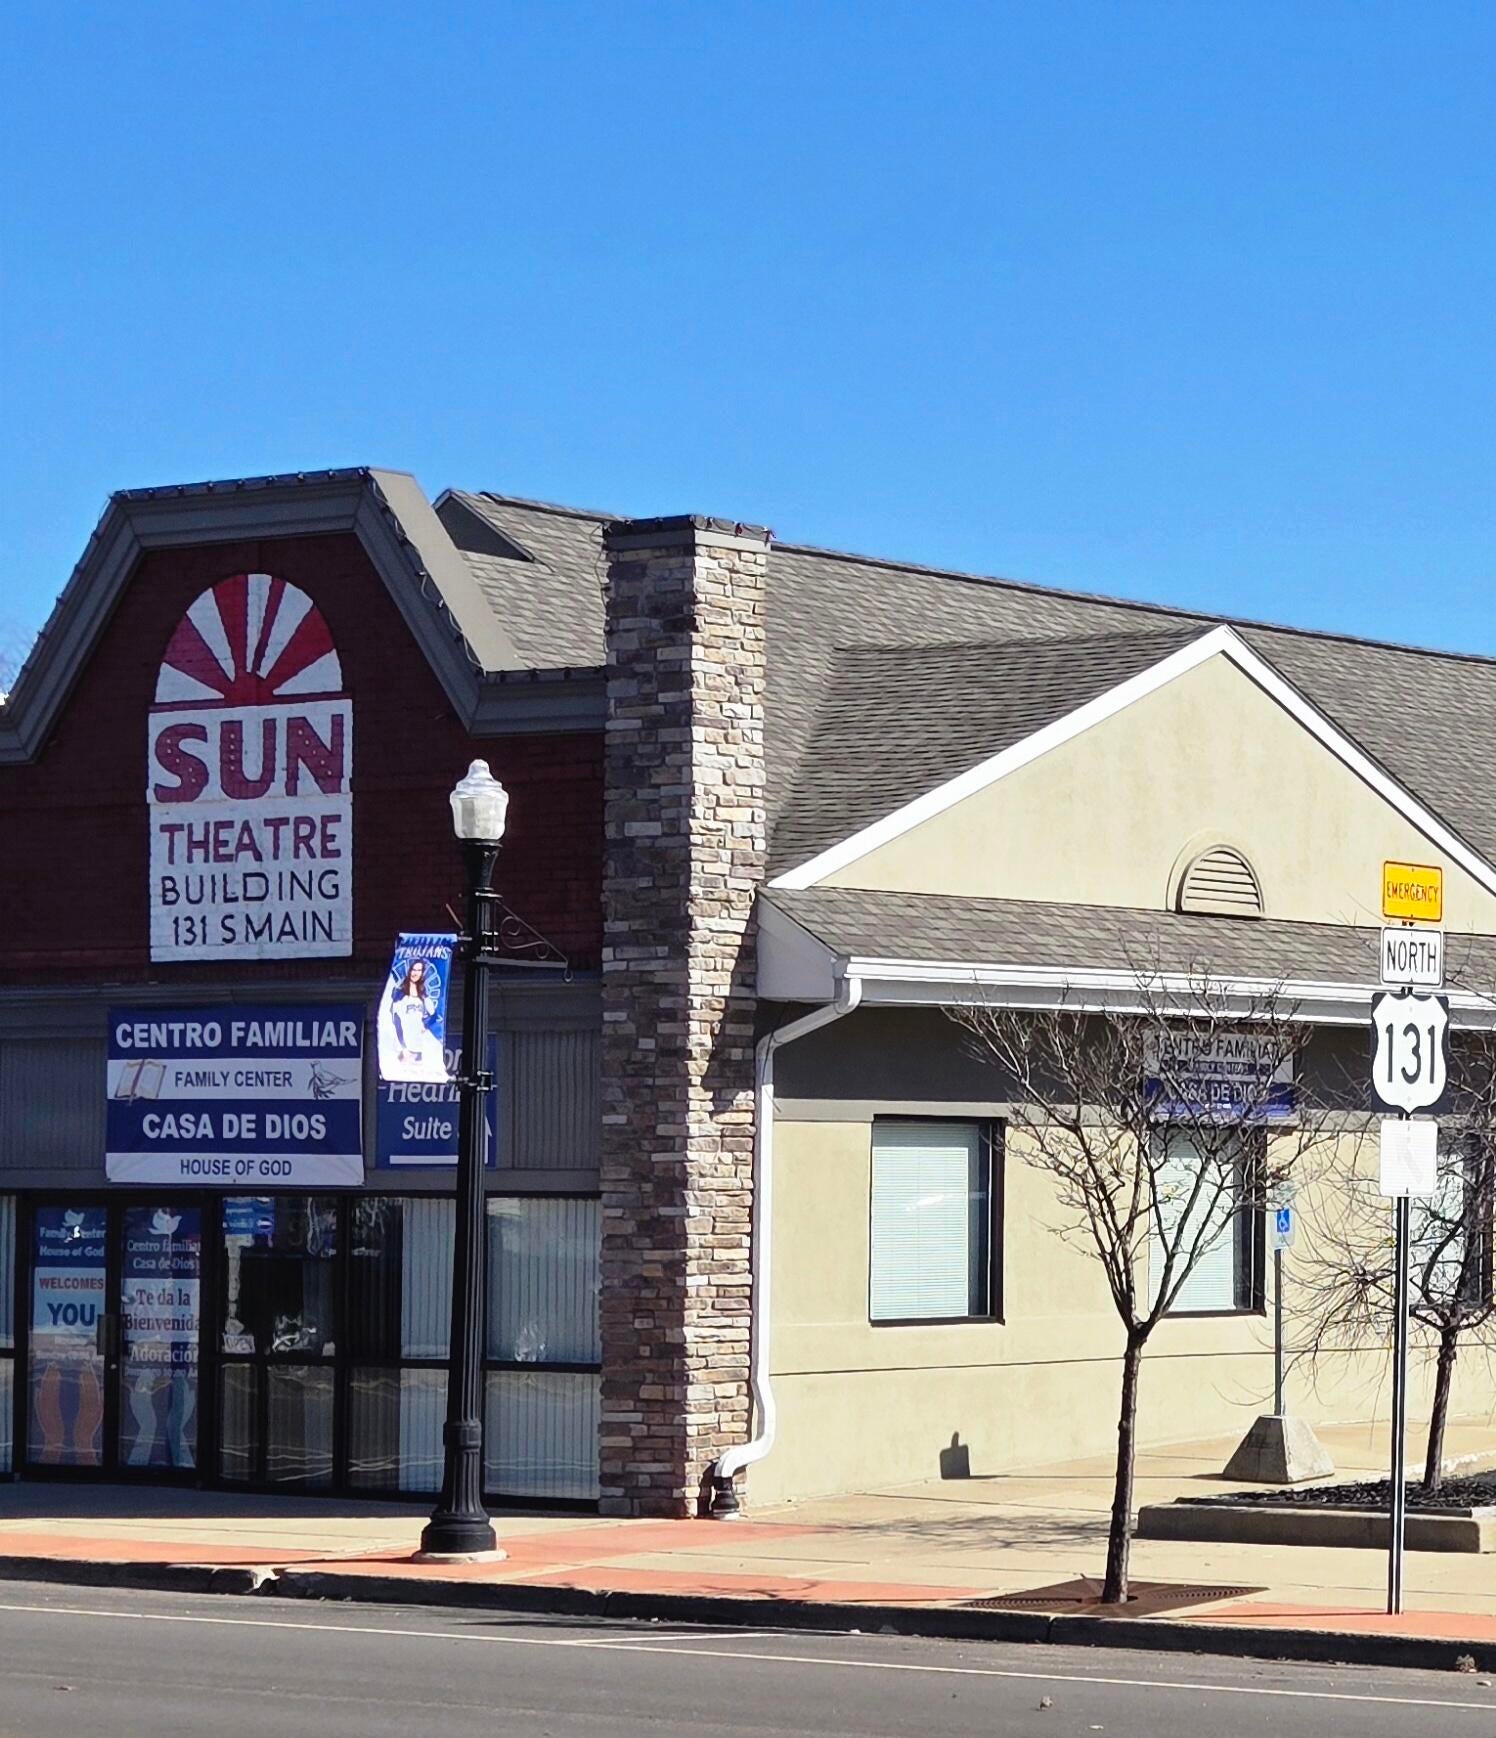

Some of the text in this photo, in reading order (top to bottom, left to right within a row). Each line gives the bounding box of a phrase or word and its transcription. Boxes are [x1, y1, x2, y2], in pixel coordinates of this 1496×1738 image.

[153, 714, 344, 803] SUN
[159, 814, 342, 866] THEATRE
[161, 869, 340, 906] BUILDING
[1386, 881, 1439, 903] EMERGENCY
[172, 910, 333, 946] 131 S MAIN
[1386, 940, 1437, 973] NORTH
[116, 1021, 358, 1048] CENTRO FAMILIAR
[1386, 1023, 1435, 1084] 131
[175, 1071, 293, 1087] FAMILY CENTER
[142, 1113, 327, 1140] CASA DE DIOS
[402, 1116, 452, 1140] Suite
[180, 1159, 292, 1176] HOUSE OF GOD
[39, 1278, 104, 1290] WELCOMES
[136, 1288, 191, 1306] Te da la
[47, 1303, 95, 1326] YOU
